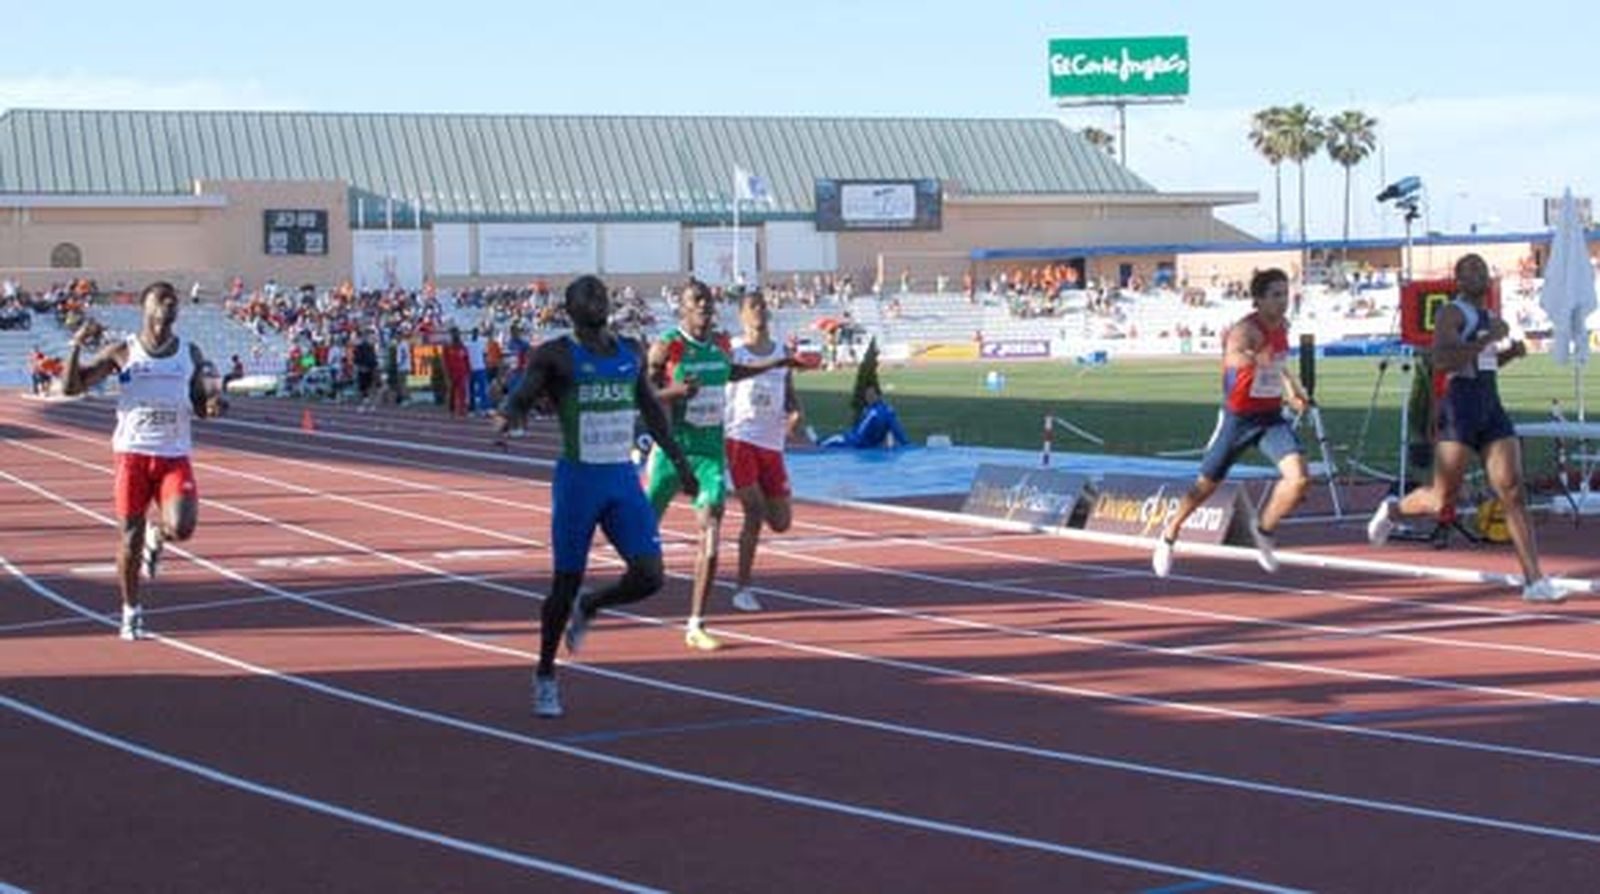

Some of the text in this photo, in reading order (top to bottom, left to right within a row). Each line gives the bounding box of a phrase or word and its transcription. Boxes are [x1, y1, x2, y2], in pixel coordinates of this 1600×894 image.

[1050, 54, 1071, 76] El
[1072, 53, 1118, 75] Corte
[578, 384, 635, 403] BRASIL
